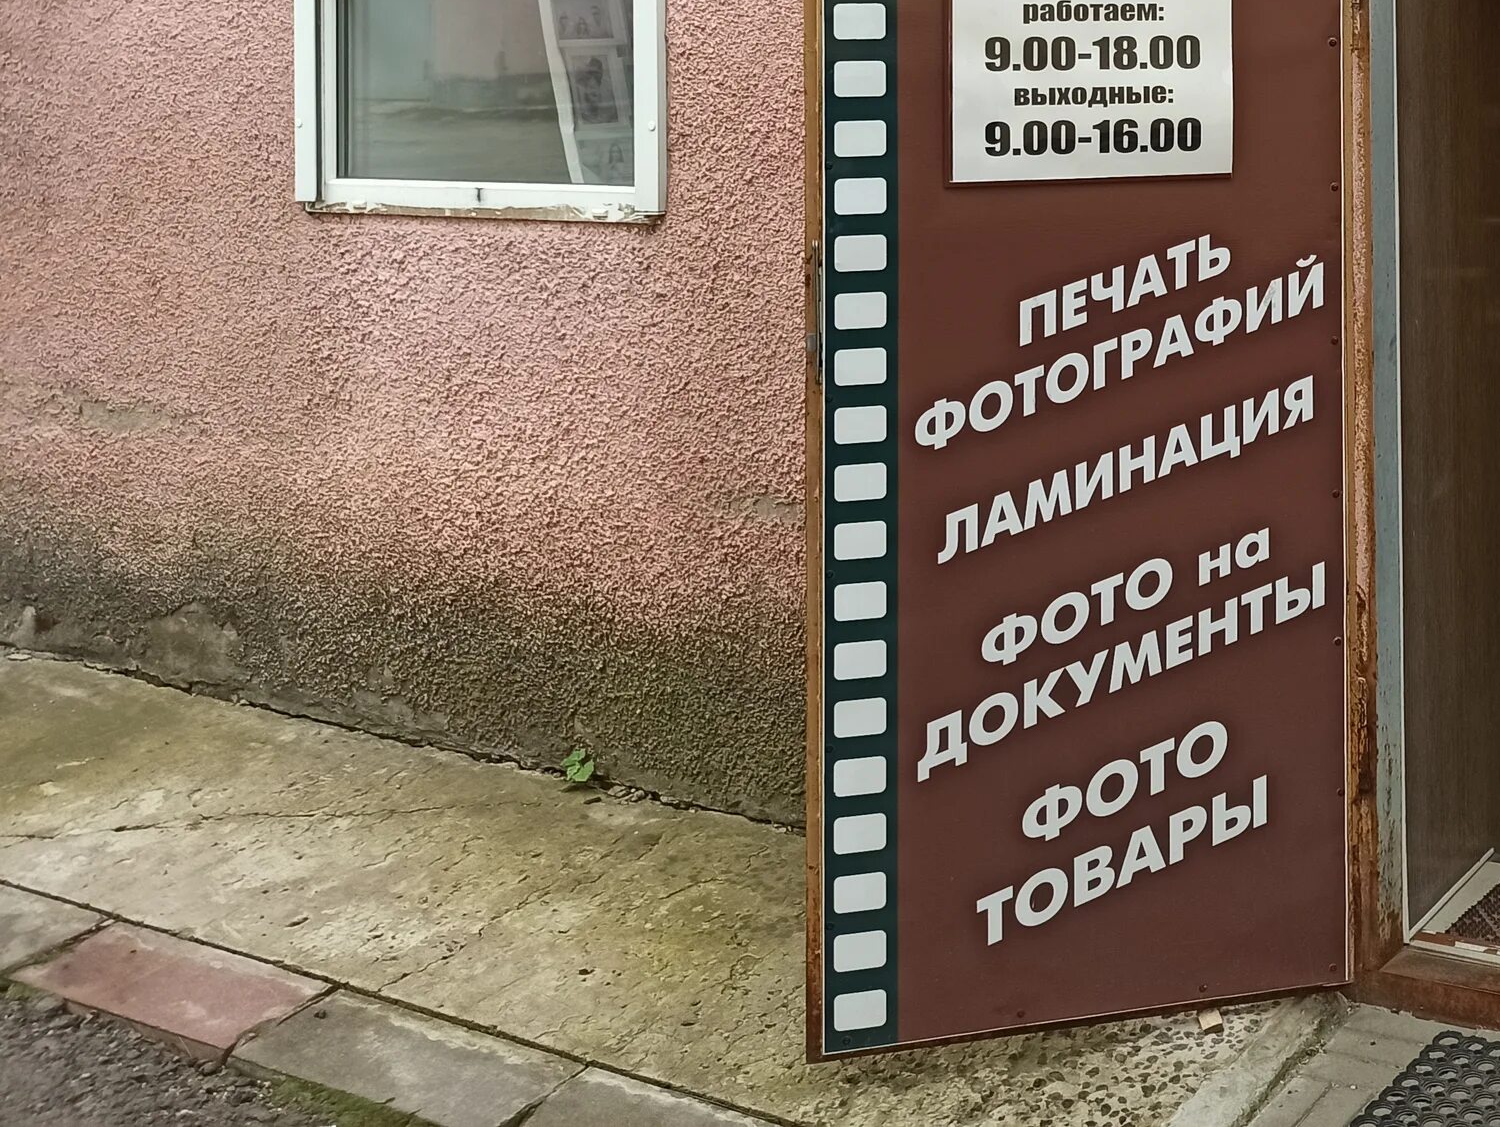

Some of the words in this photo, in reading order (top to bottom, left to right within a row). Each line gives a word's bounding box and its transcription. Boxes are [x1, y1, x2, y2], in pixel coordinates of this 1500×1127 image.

[984, 34, 1202, 72] 9.00-18.00
[1022, 0, 1165, 25] работаем:
[984, 117, 1202, 157] 9.00-16.00
[1014, 85, 1174, 108] выходные:
[1019, 233, 1231, 347] ПЕЧАТЬ
[914, 254, 1324, 451] ФОТОГРАФИЙ
[937, 374, 1314, 565] ЛАМИНАЦИЯ
[981, 558, 1173, 666] ФОТО
[1198, 527, 1271, 587] на
[917, 561, 1326, 783] ДОКУМЕНТЫ
[1021, 720, 1228, 842] ФОТО
[976, 774, 1268, 946] ТОВАРЫ
